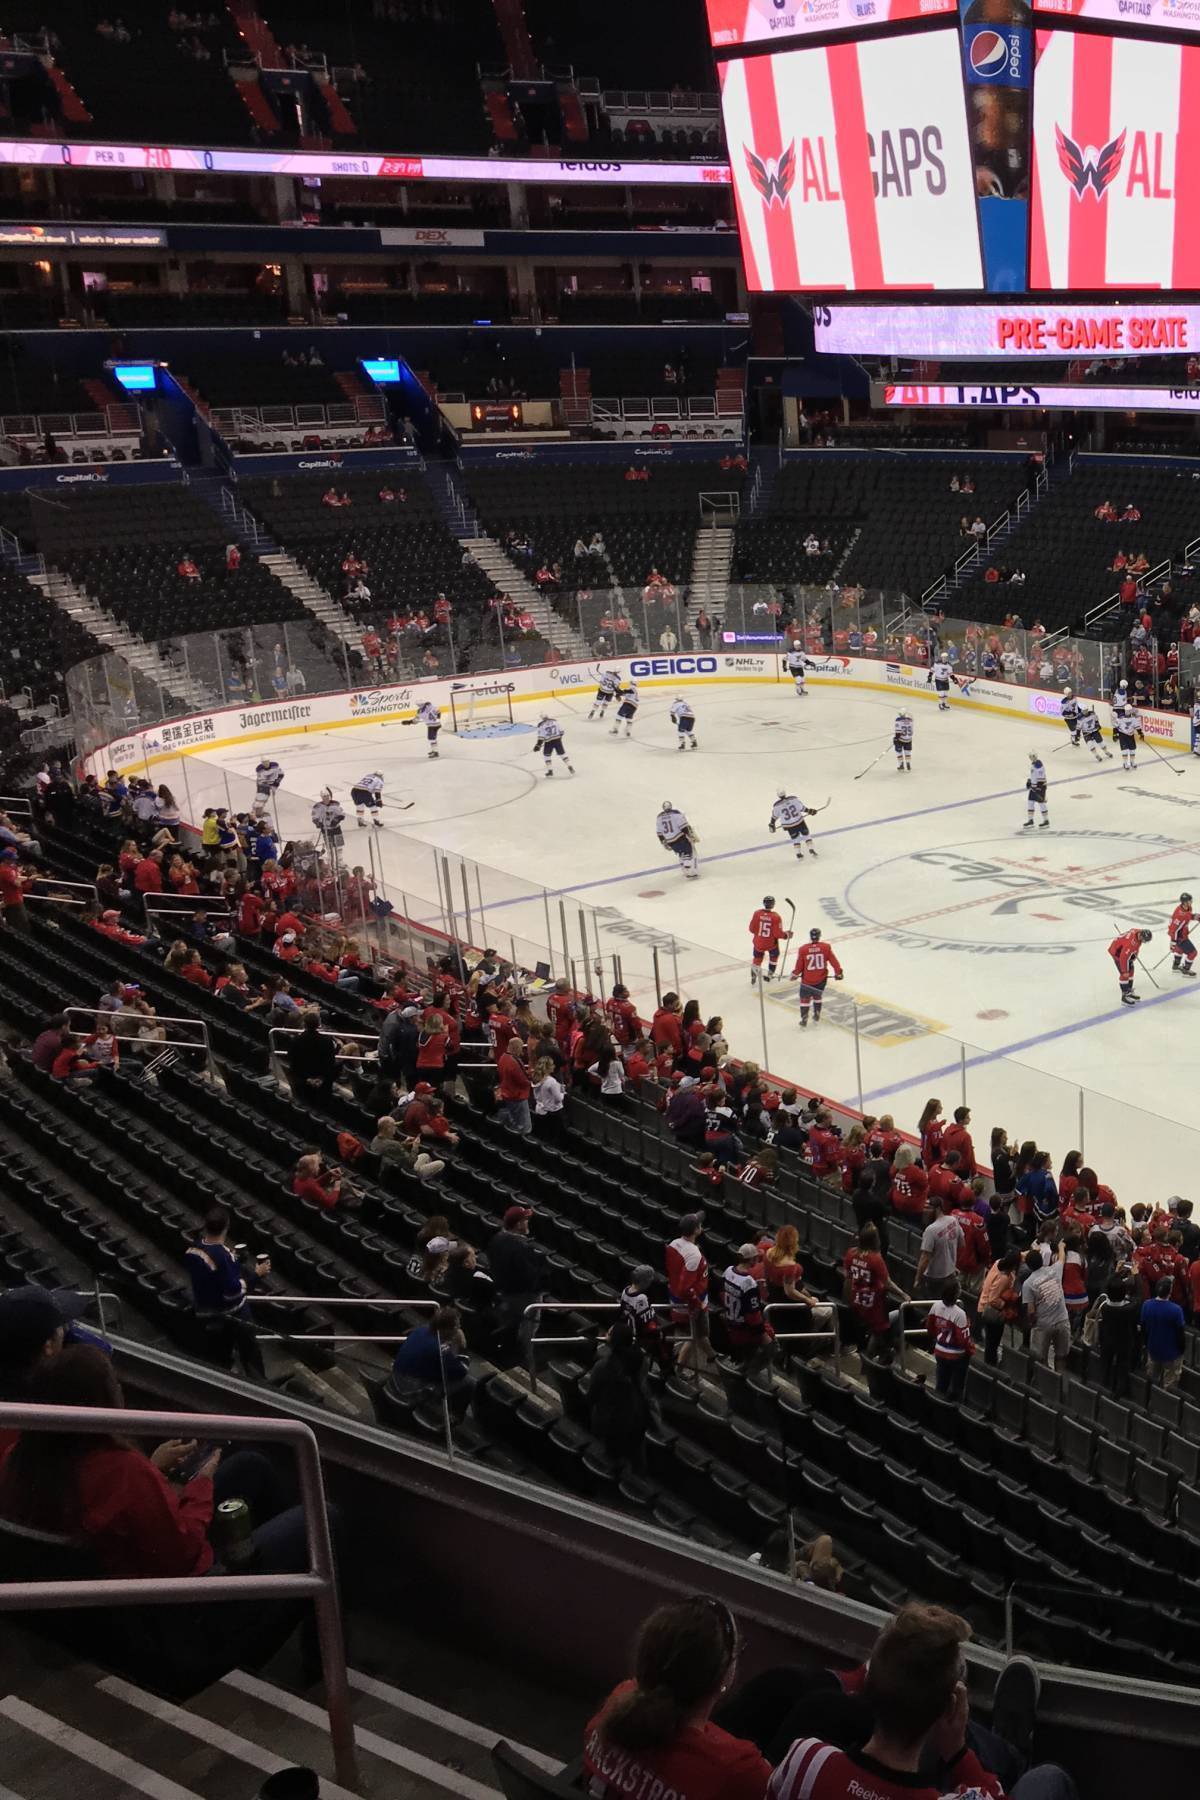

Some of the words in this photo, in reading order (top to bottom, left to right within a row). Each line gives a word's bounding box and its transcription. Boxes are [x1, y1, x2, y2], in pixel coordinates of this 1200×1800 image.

[856, 2, 876, 16] BLUES
[1118, 0, 1151, 16] CAPITALS
[769, 15, 796, 30] CAPITALS
[1009, 34, 1020, 78] pepsi
[95, 151, 113, 163] PER
[143, 146, 173, 169] 7:10
[1126, 130, 1173, 200] AL
[803, 134, 842, 202] AL
[998, 317, 1125, 350] PRE-GAME
[1128, 316, 1188, 349] SKATE
[630, 657, 717, 677] GEICO
[559, 673, 583, 685] WGL
[351, 702, 411, 717] WASHINGTON
[1143, 725, 1174, 737] DONUTS
[781, 805, 799, 821] 32
[661, 820, 675, 834] 31
[758, 920, 772, 938] 15
[806, 953, 824, 971] 20
